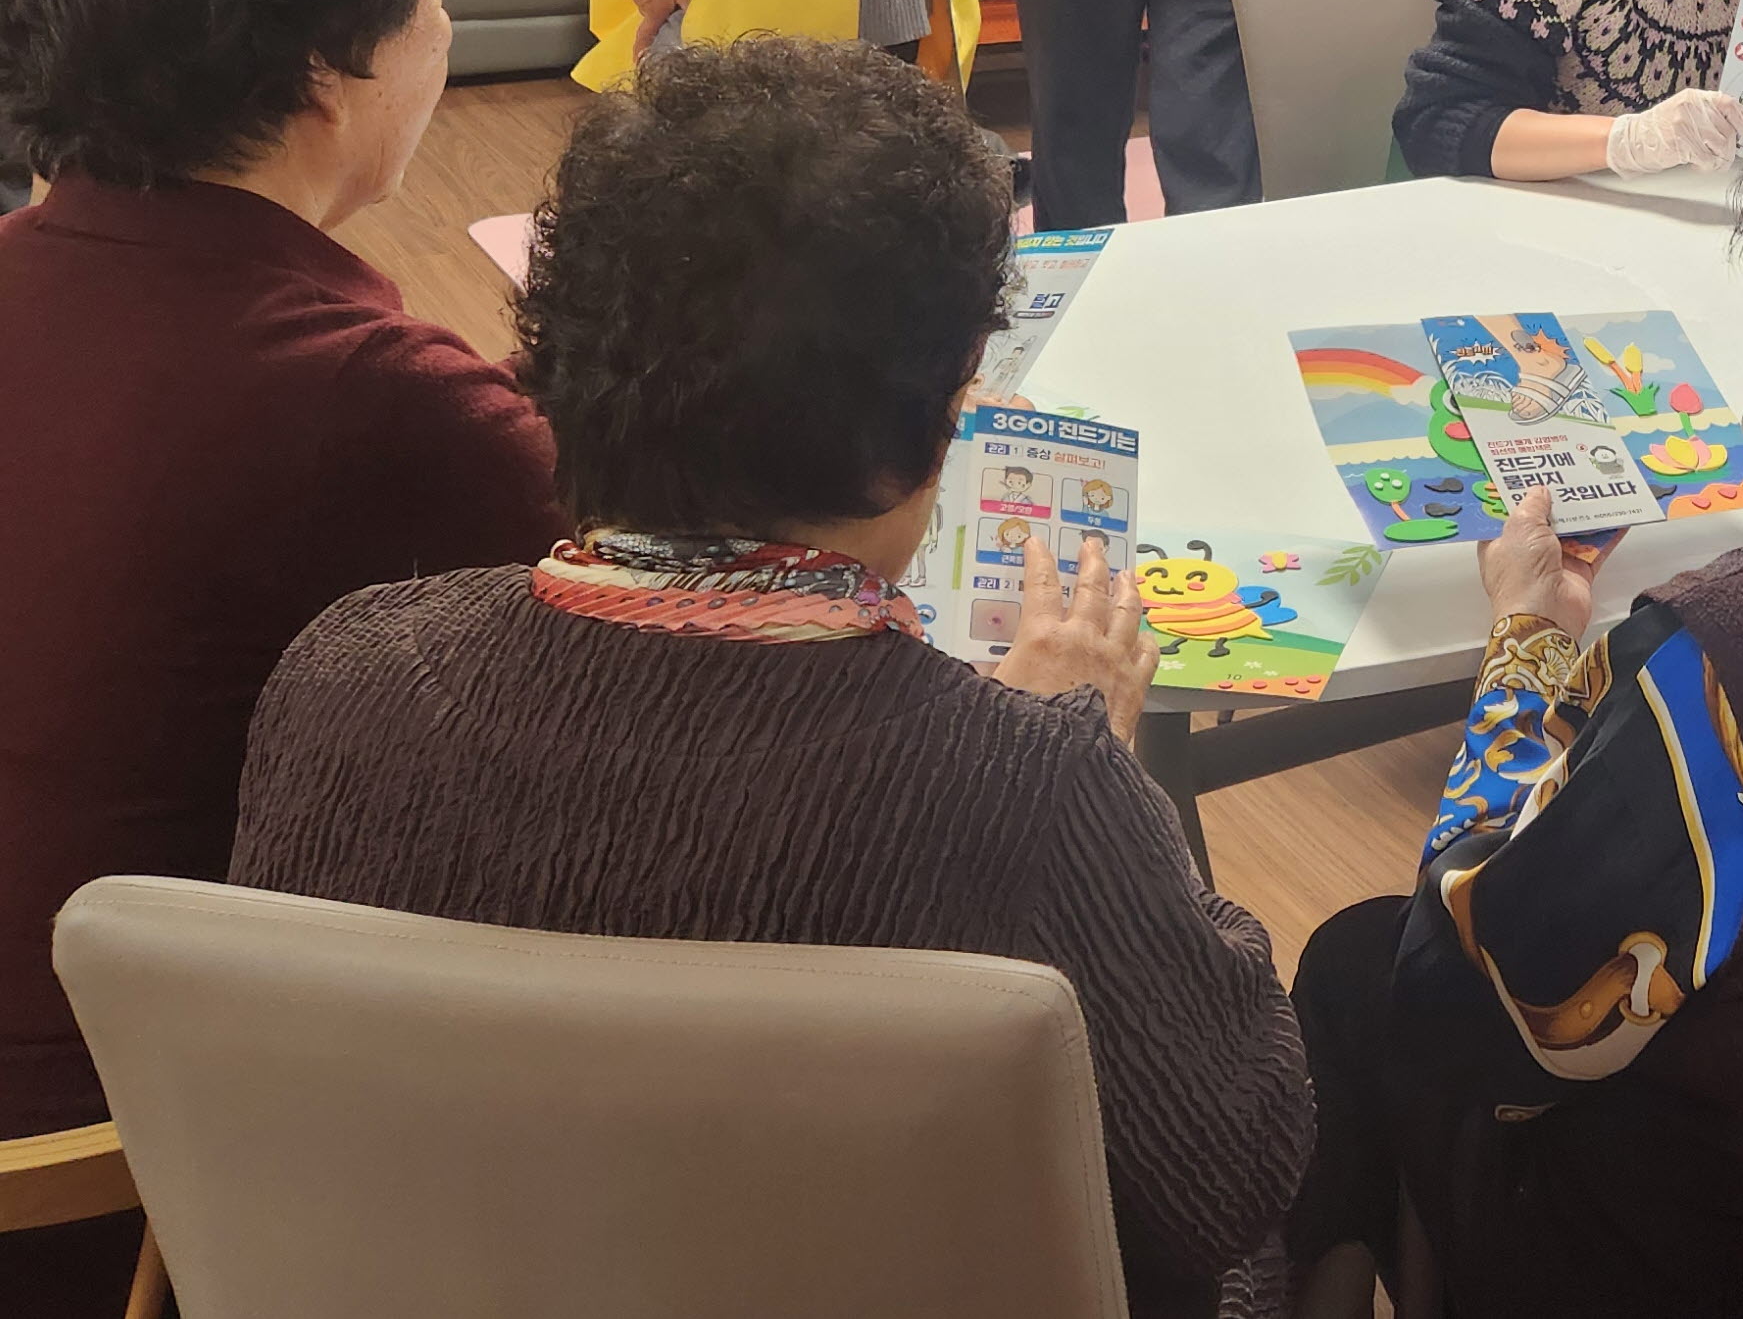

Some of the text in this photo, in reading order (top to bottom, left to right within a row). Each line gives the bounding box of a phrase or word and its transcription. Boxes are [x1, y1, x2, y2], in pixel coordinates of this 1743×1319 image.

[1059, 420, 1136, 452] 진드기는
[1487, 440, 1513, 449] 진드기
[1026, 447, 1051, 460] 증상
[1494, 452, 1576, 473] 진드기에
[1503, 471, 1565, 490] 물리지
[1556, 481, 1637, 502] 것입니다
